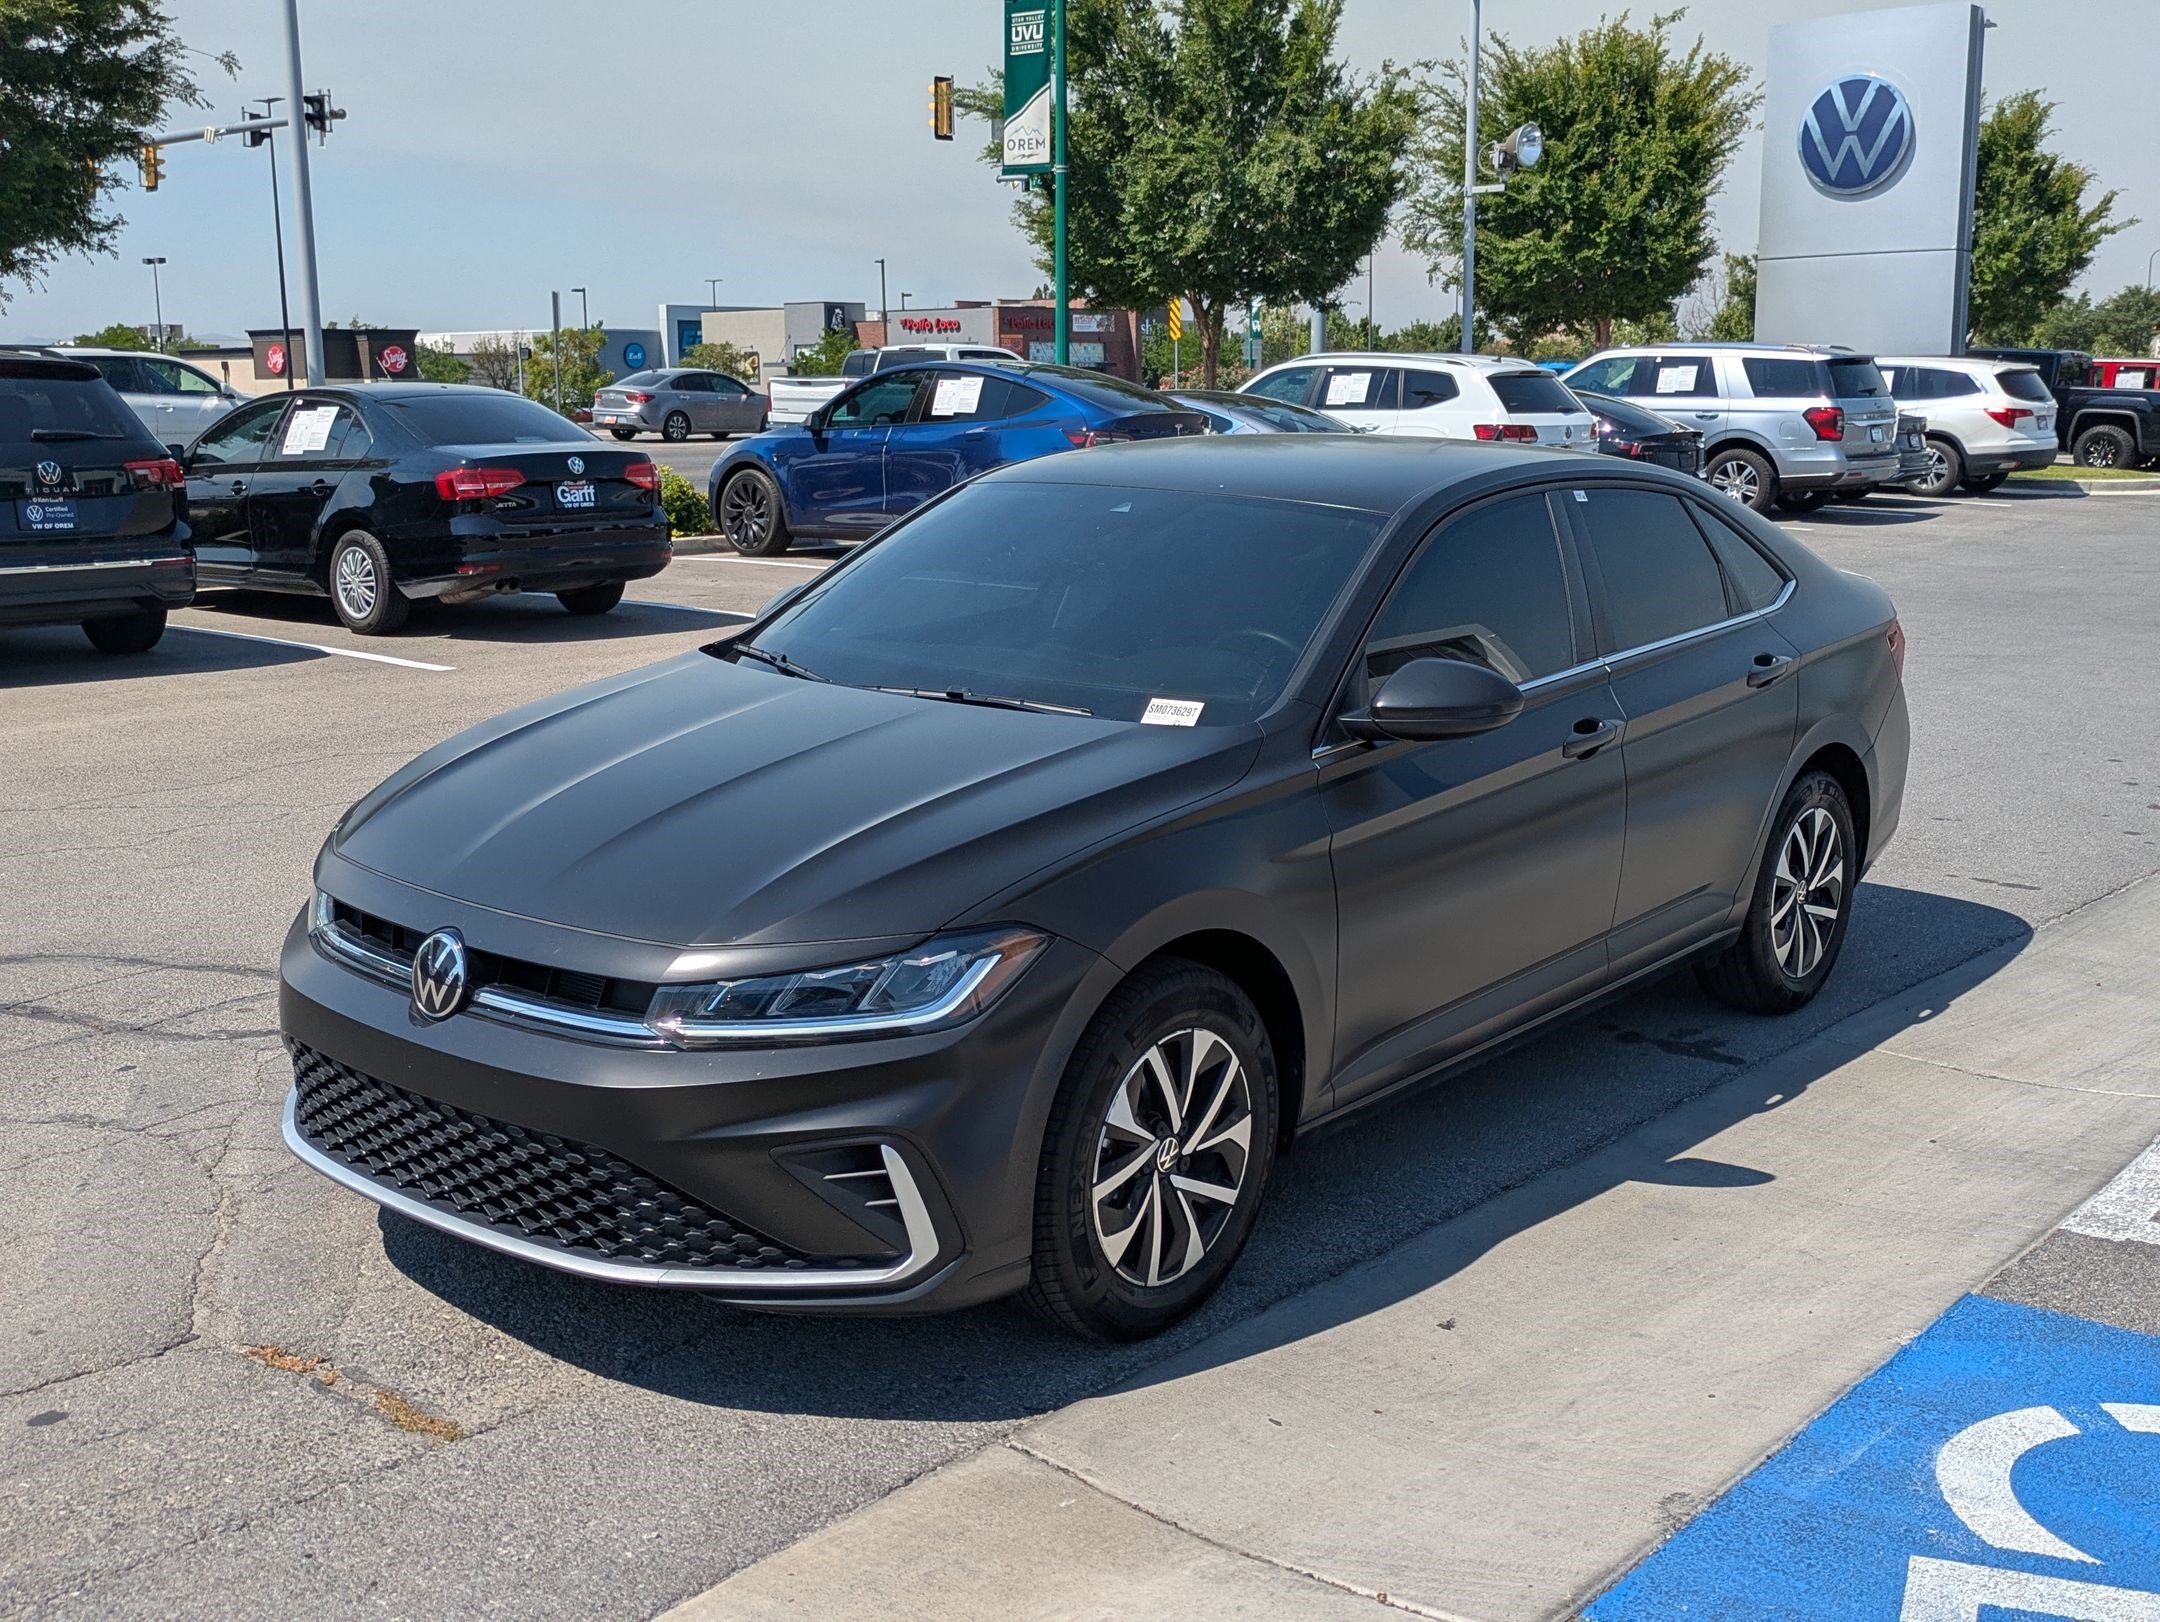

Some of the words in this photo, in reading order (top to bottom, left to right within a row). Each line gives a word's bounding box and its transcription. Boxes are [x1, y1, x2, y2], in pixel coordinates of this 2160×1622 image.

[1011, 24, 1044, 42] UVU
[1006, 137, 1046, 151] OREM
[934, 318, 959, 330] Loco
[267, 348, 285, 369] Swig
[382, 349, 408, 369] Swig
[25, 486, 80, 494] TIGUAN
[557, 485, 595, 503] Garff
[1148, 703, 1198, 717] SM073629T
